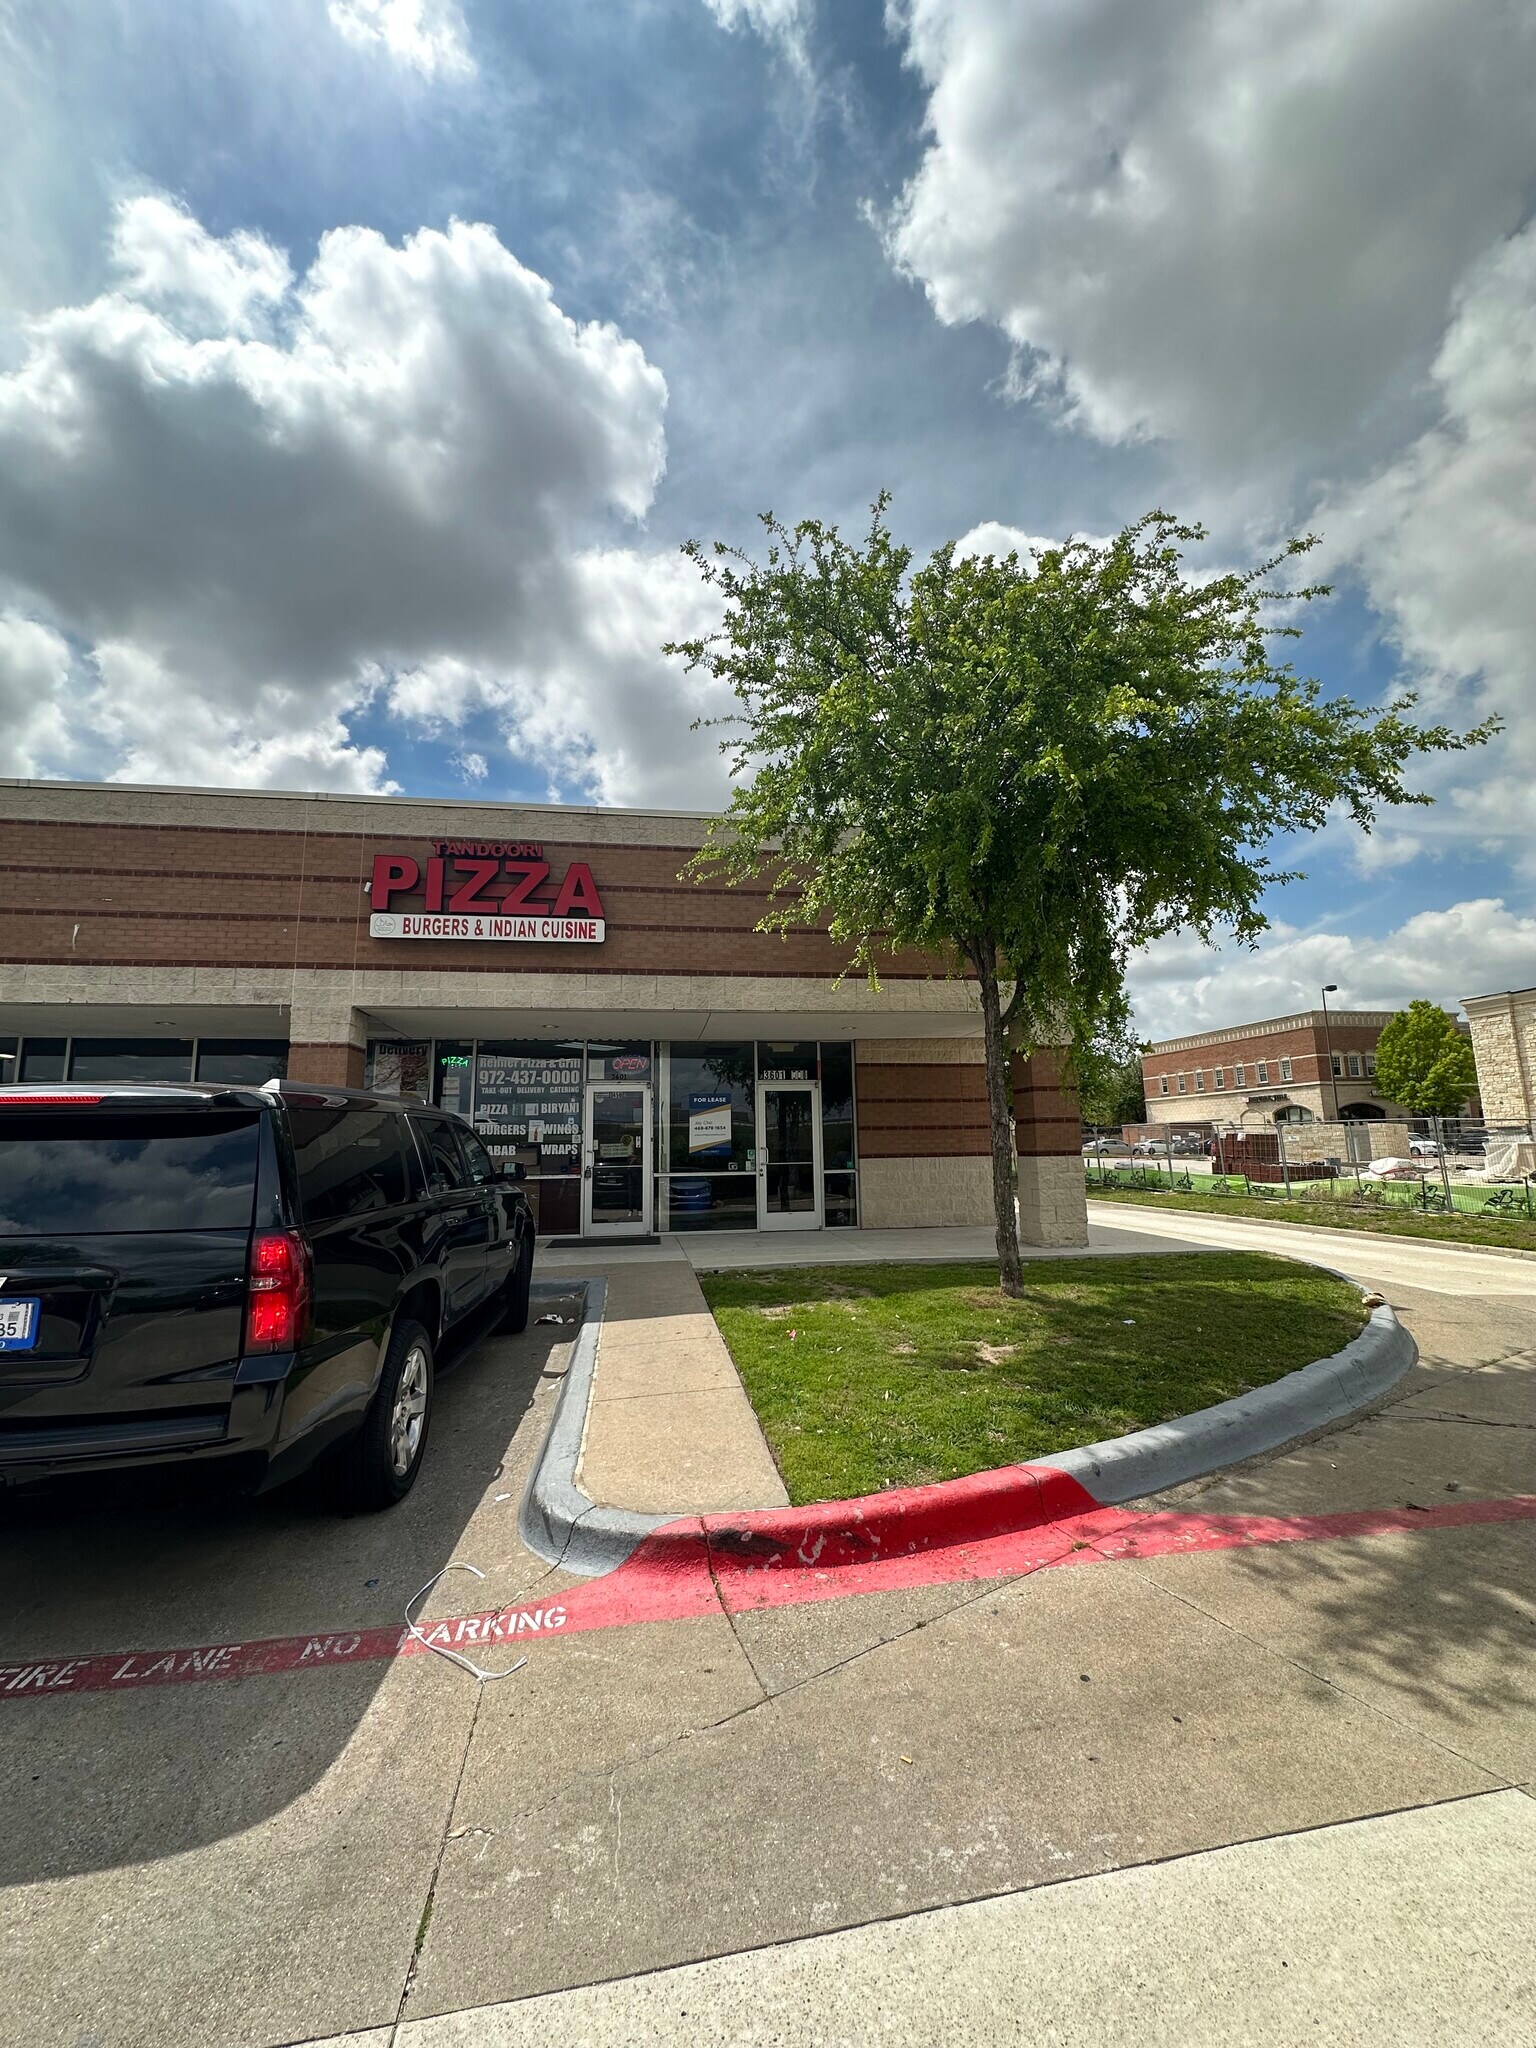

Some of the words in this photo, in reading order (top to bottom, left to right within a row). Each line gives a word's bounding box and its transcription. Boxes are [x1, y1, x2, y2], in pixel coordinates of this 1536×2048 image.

[432, 841, 543, 857] TANDOORI
[371, 855, 605, 918] PIZZA
[402, 917, 469, 936] BURGERS
[474, 919, 484, 936] &
[489, 919, 537, 938] INDIAN
[541, 920, 597, 940] CUISINE
[441, 1056, 470, 1068] PIZZA
[520, 1058, 547, 1068] Pizza
[558, 1058, 581, 1069] Grill
[613, 1058, 647, 1069] OPEN
[479, 1070, 580, 1085] 972-437-0000
[480, 1103, 508, 1115] PIZZA
[541, 1102, 580, 1114] BIRYANI
[479, 1124, 527, 1136] BURGERS
[543, 1123, 579, 1135] WINGS
[486, 1145, 517, 1156] ABAB
[541, 1144, 578, 1155] WRAPS
[0, 1660, 91, 1690] FIRE
[111, 1646, 242, 1680] LANE
[300, 1635, 361, 1660] NO
[396, 1606, 567, 1649] PARKING
